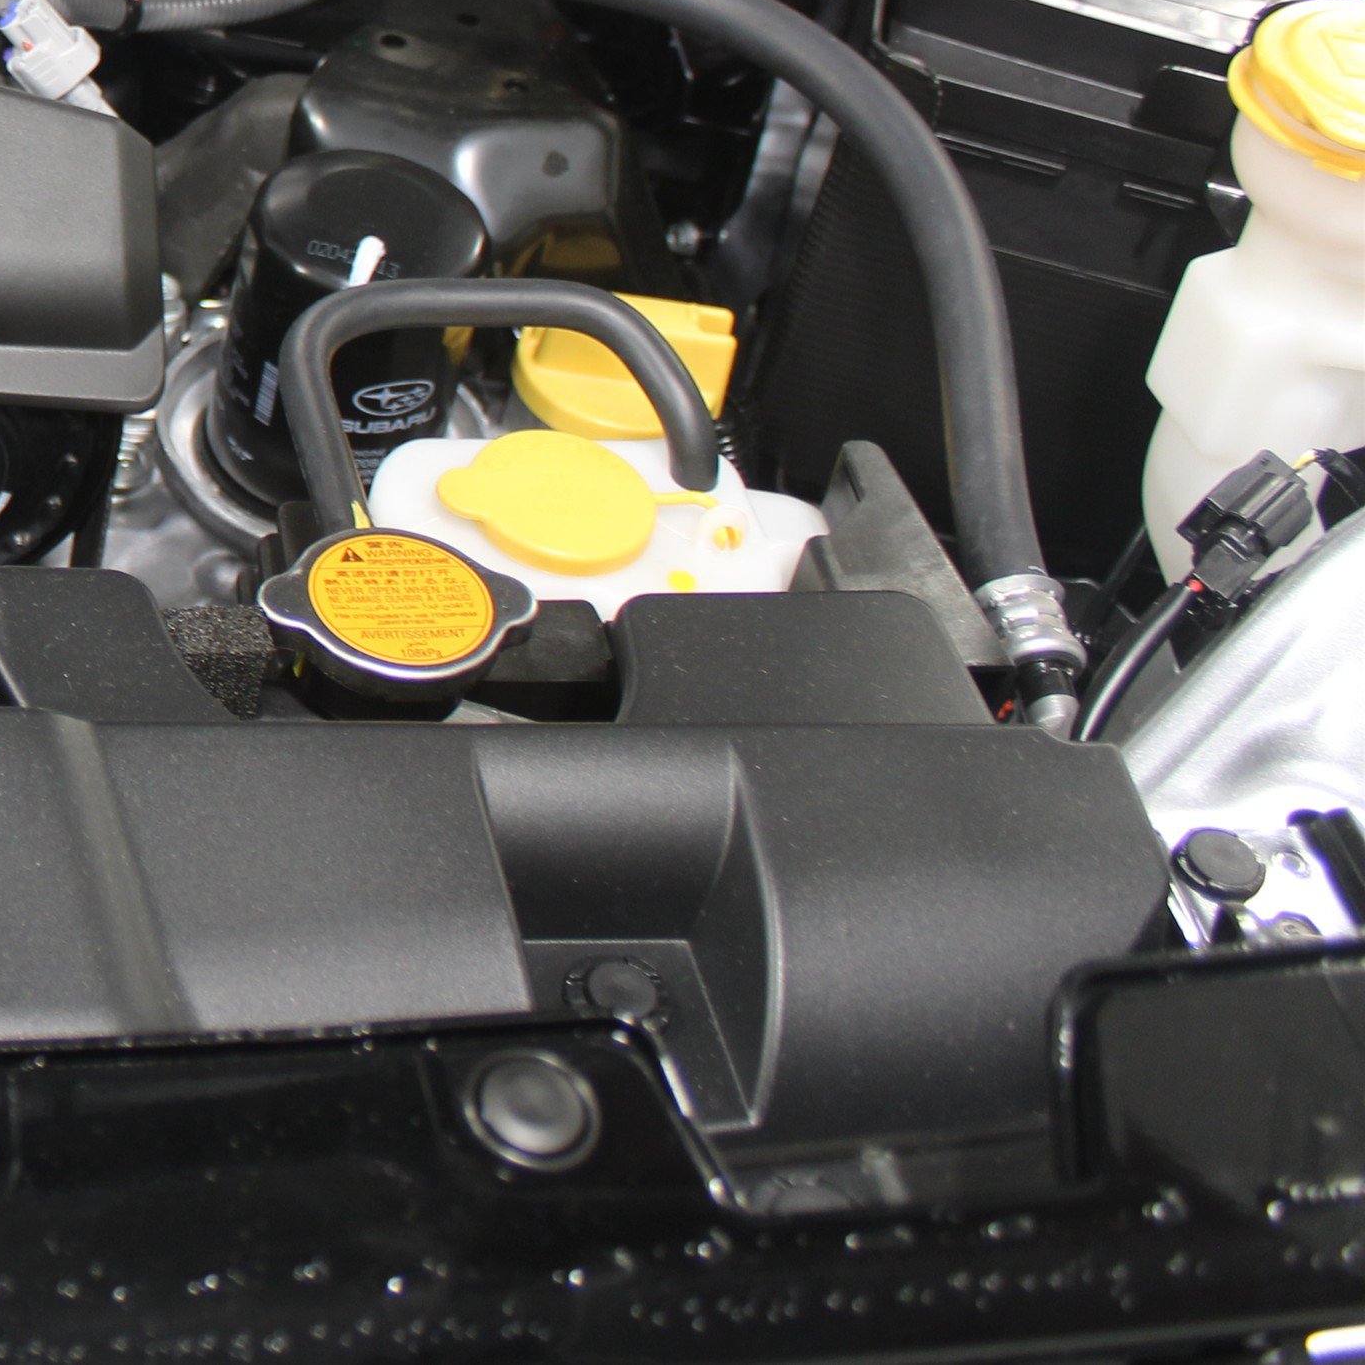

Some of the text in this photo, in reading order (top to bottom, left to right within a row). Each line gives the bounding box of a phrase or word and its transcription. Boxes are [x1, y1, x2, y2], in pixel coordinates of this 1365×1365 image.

[341, 407, 437, 434] SUBARU
[364, 549, 433, 558] WARNING
[325, 586, 363, 595] NEVER
[369, 586, 401, 595] OPEN
[405, 585, 440, 594] WHEN
[360, 628, 466, 639] AVERTISSEMENT
